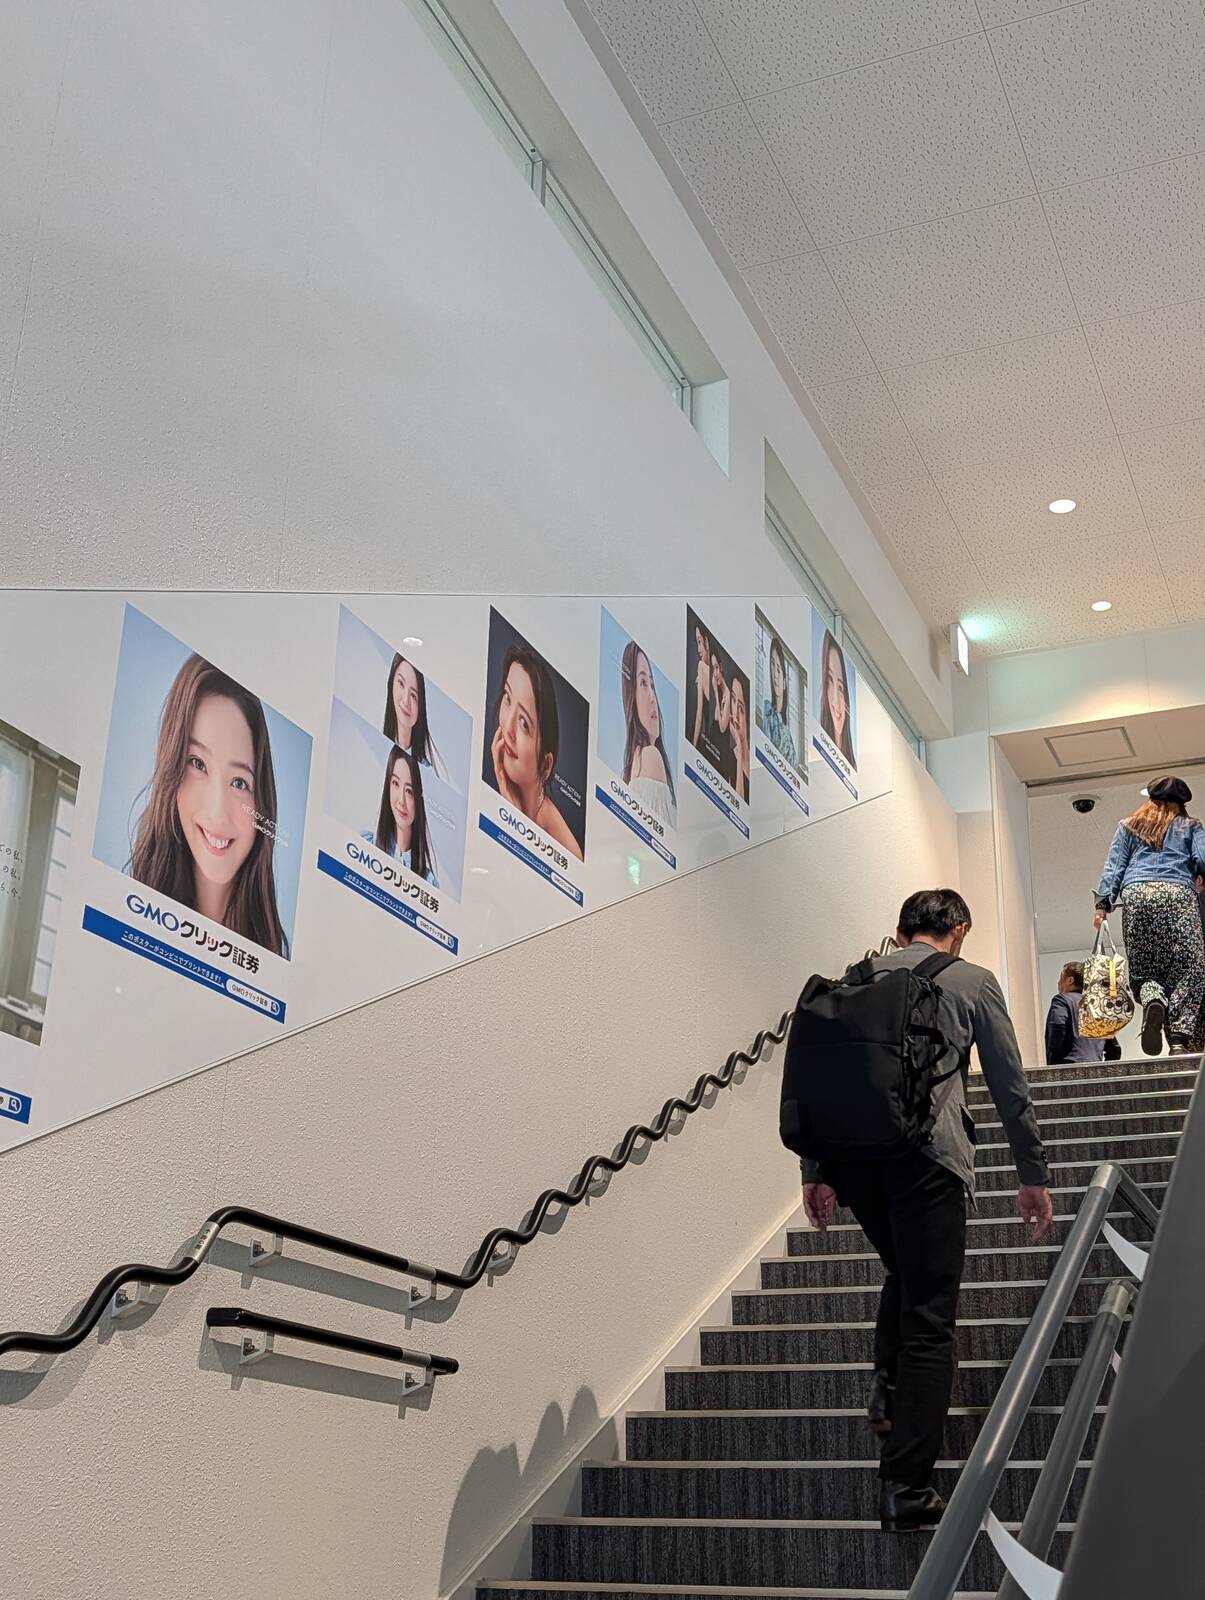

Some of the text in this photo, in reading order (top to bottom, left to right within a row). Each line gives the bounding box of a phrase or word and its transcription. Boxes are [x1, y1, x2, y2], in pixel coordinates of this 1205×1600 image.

[498, 807, 568, 871] GMOクリック証券
[346, 842, 440, 914] GMOクリック証券
[125, 894, 260, 974] GMOクリック証券
